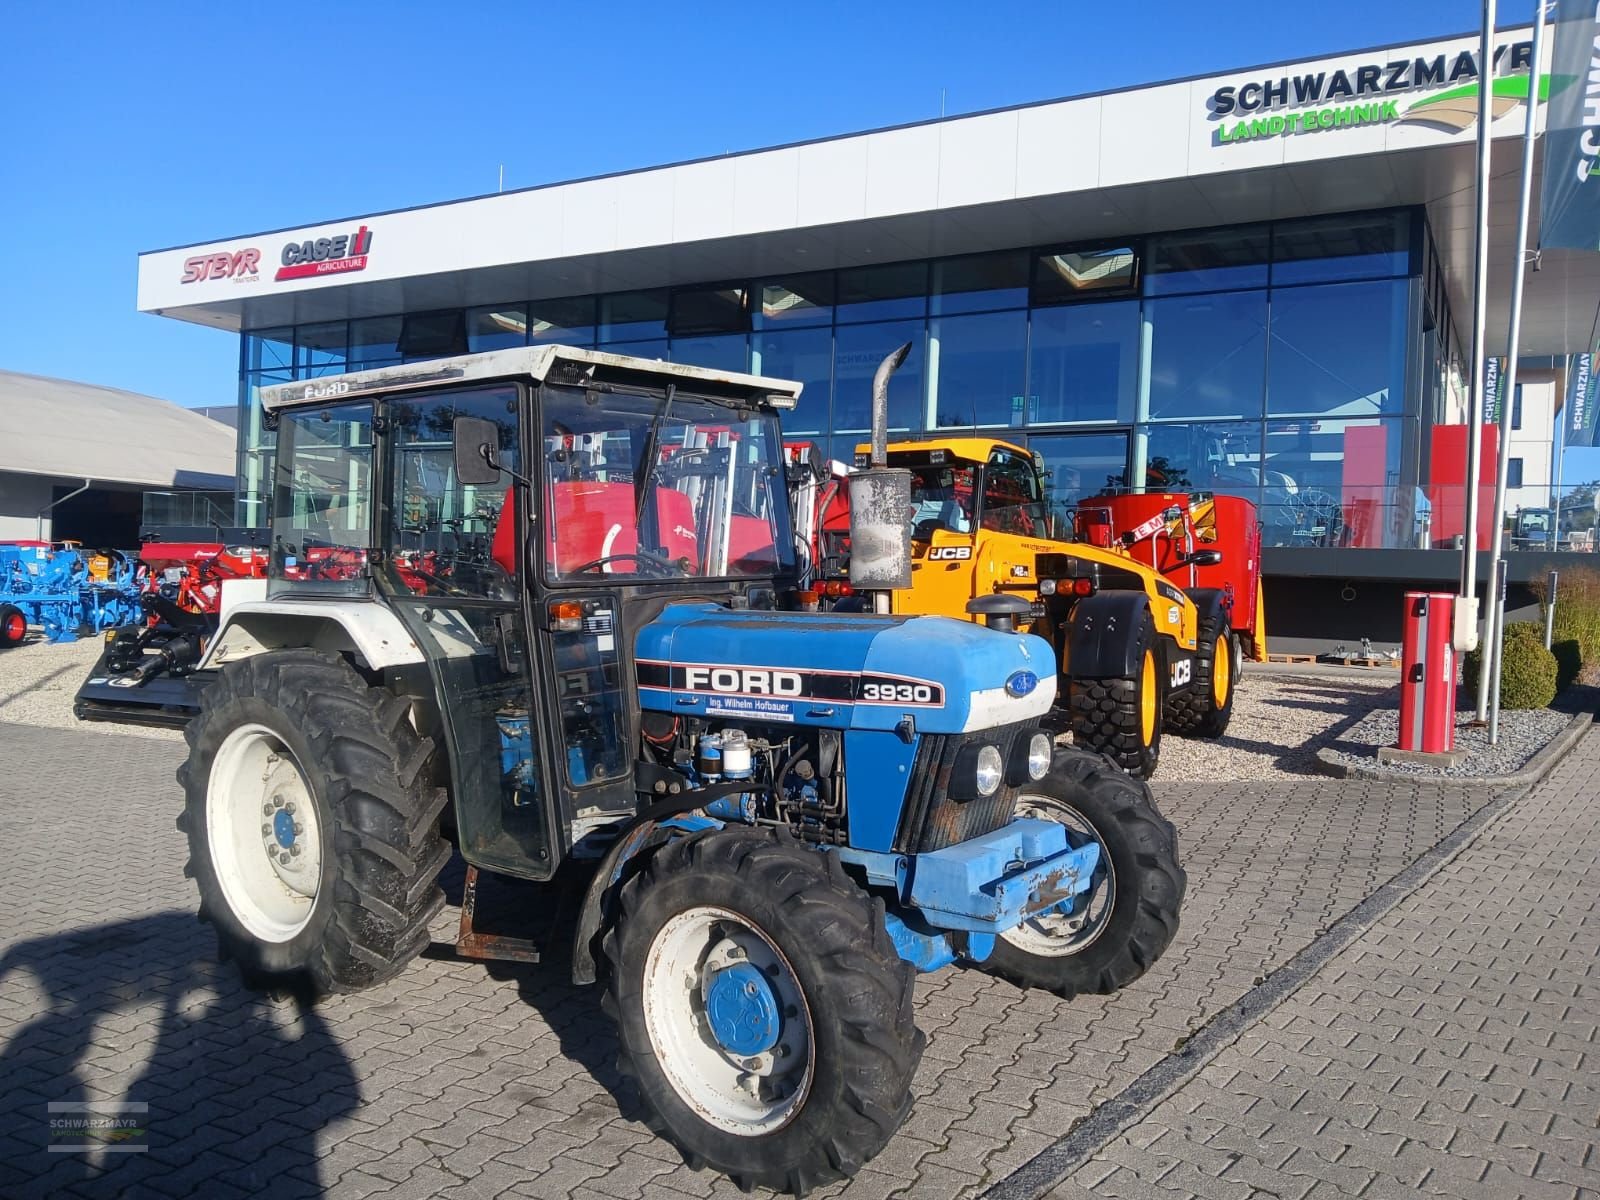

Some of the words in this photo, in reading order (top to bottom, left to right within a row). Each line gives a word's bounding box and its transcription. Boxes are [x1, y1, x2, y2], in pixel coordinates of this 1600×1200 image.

[1213, 40, 1534, 115] SCHWARZMAYR
[1218, 99, 1400, 143] LANDTECHNIK
[181, 248, 261, 284] STEYR
[281, 236, 349, 267] CASE
[316, 257, 363, 273] AGRICULTURE
[930, 547, 971, 560] JCB
[685, 667, 802, 697] FORD
[1171, 659, 1191, 688] JCB
[709, 697, 722, 708] Ing.
[724, 698, 753, 709] Wilhelm
[755, 700, 789, 712] Hofbauer
[863, 684, 932, 703] 3930
